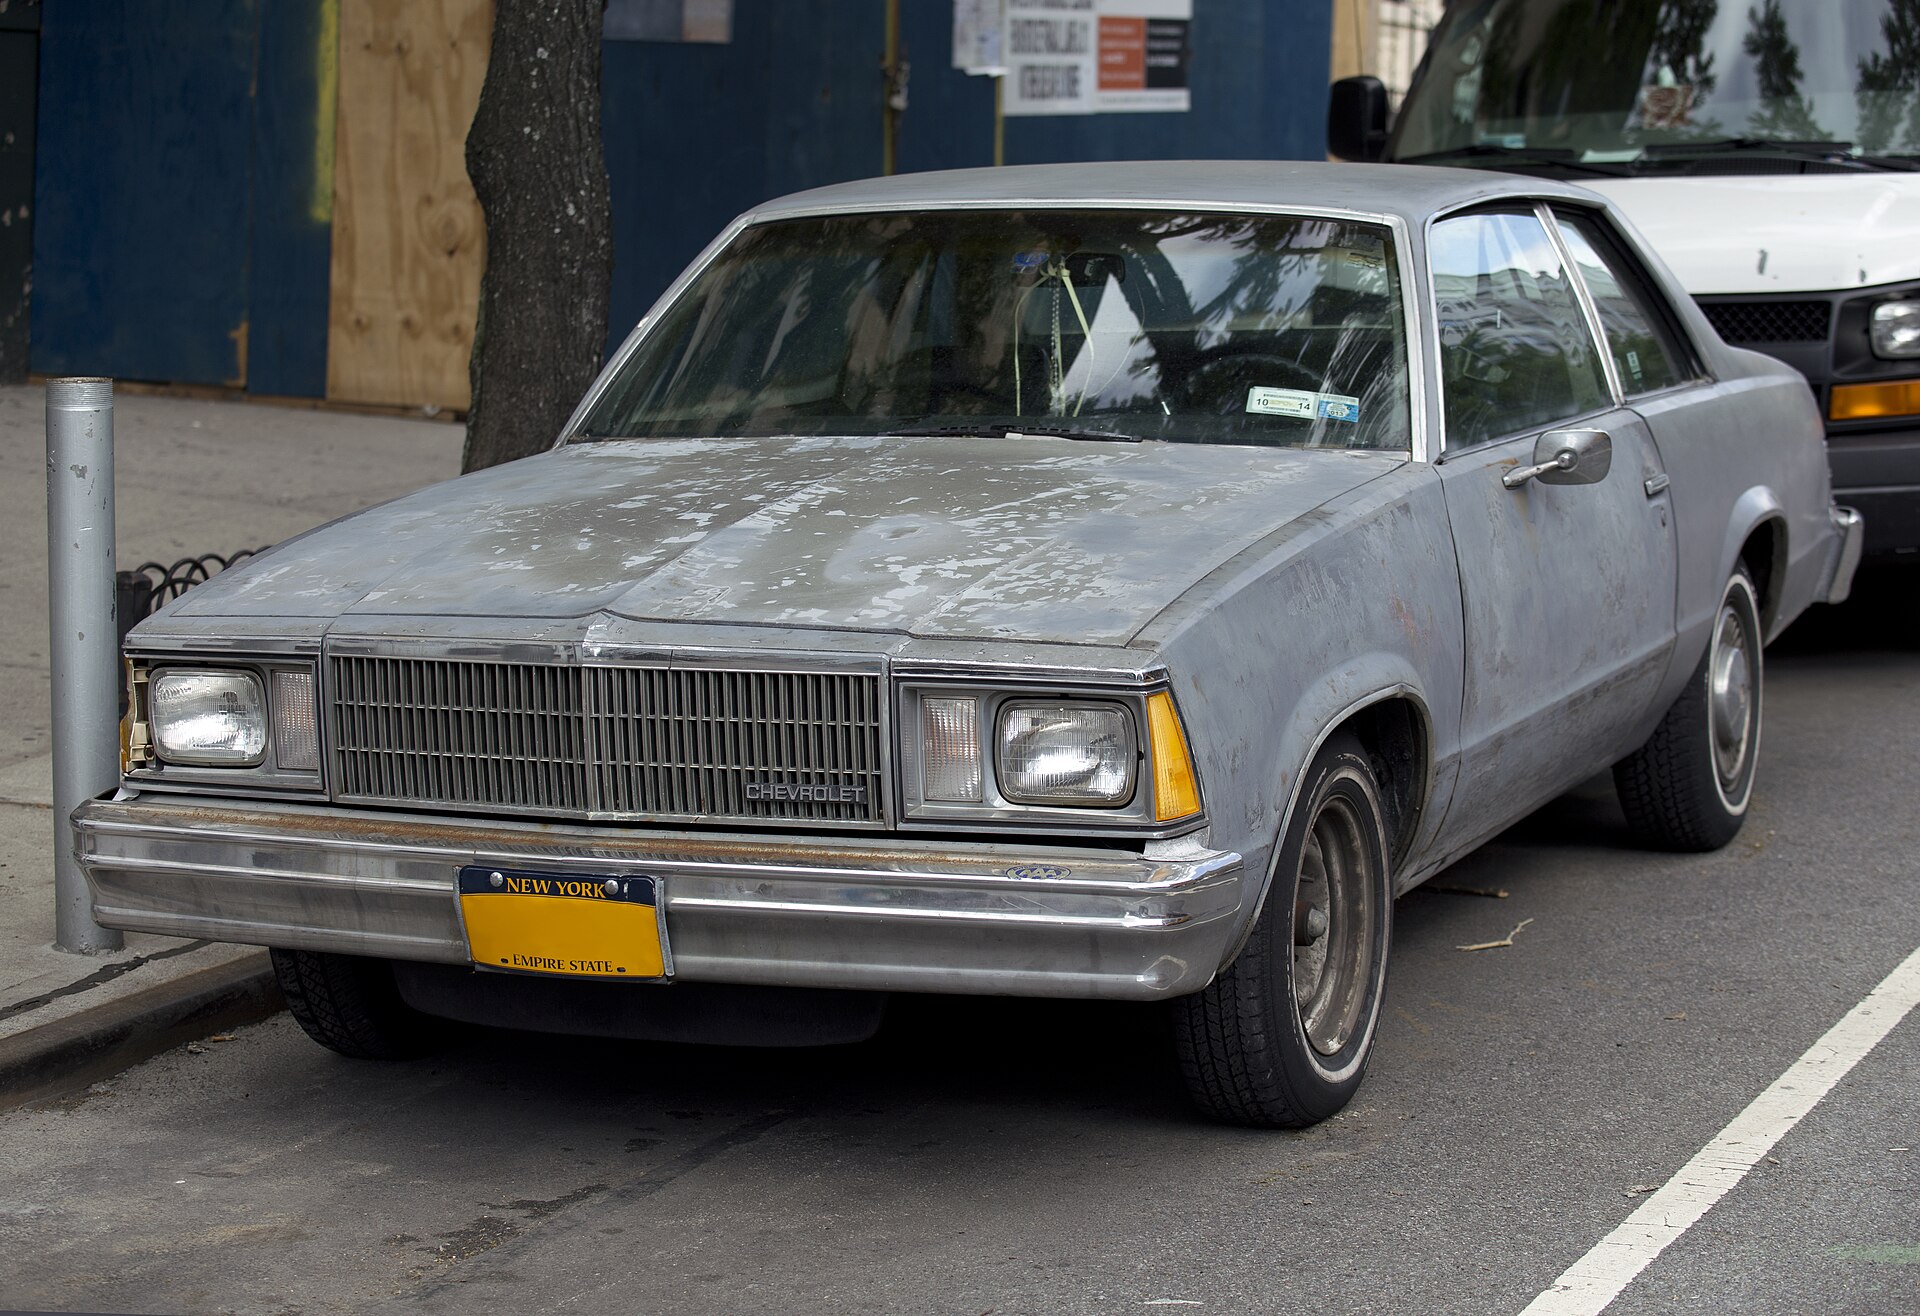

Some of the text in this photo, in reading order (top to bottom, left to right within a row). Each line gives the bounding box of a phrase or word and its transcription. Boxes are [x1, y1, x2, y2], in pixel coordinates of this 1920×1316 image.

[1256, 398, 1269, 406] 10
[1298, 402, 1311, 411] 14
[746, 784, 864, 802] CHEVROLET
[506, 877, 606, 899] NEW YORK
[513, 953, 613, 973] EMPIRE STATE
